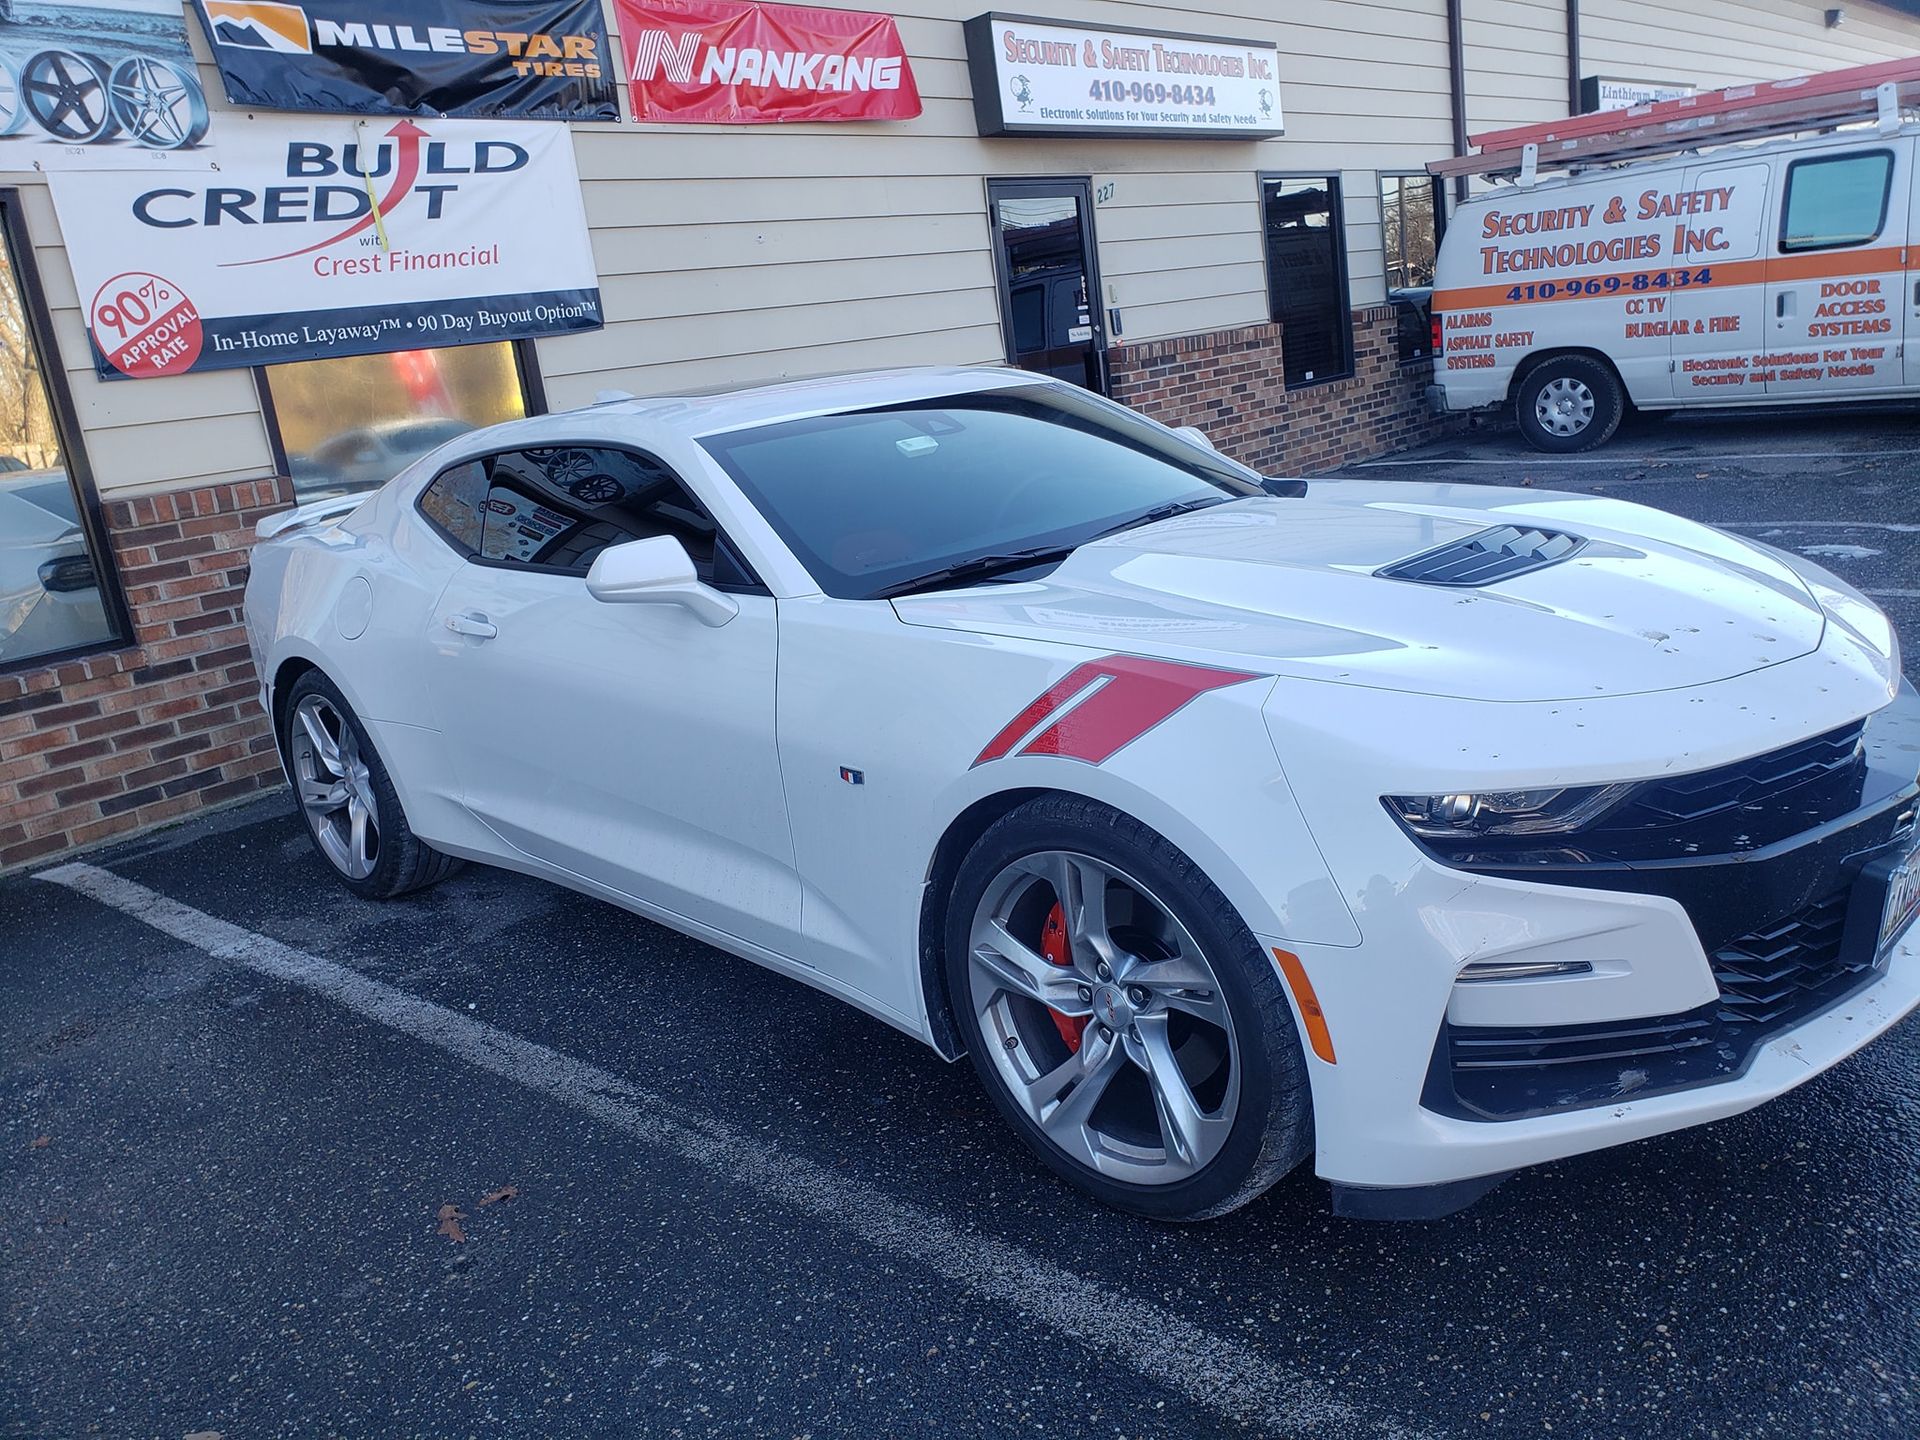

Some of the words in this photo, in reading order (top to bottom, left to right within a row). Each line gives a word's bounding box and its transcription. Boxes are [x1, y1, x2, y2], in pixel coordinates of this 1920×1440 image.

[1003, 30, 1077, 67] SECURITY
[1083, 39, 1098, 68] &
[1101, 39, 1150, 72] SAFETY
[1152, 43, 1244, 78] TECHNOLOGIES
[1247, 52, 1273, 80] INC.
[512, 61, 602, 79] TIRES
[699, 46, 902, 92] NANKANG
[1088, 79, 1216, 106] 410-969-8434
[1040, 107, 1084, 120] Electronic
[1086, 109, 1124, 121] Solutions
[1126, 110, 1139, 121] For
[1141, 111, 1158, 122] Your
[1160, 111, 1190, 124] Security
[1192, 112, 1207, 123] and
[1208, 113, 1232, 125] Safety
[1233, 113, 1257, 124] Needs
[1097, 183, 1115, 204] 227
[1482, 204, 1595, 239] SECURITY
[1603, 195, 1627, 224] &
[1637, 185, 1736, 221] SAFETY
[313, 254, 382, 277] Crest
[389, 244, 499, 272] Financial
[1480, 233, 1661, 275] TECHNOLOGIES
[1672, 224, 1730, 256] INC.
[1506, 267, 1712, 301] 410-969-8434
[1821, 279, 1881, 298] DOOR
[98, 278, 169, 339] 90%
[1625, 299, 1644, 314] CC
[1647, 296, 1667, 313] TV
[1814, 298, 1886, 318] ACCESS
[212, 330, 300, 352] In-Home
[417, 315, 438, 333] 90
[441, 313, 474, 331] Day
[477, 308, 533, 329] Buyout
[1445, 312, 1493, 330] ALARMS
[1625, 319, 1690, 338] BURGLAR
[1693, 318, 1705, 334] &
[1708, 315, 1740, 333] FIRE
[1808, 317, 1892, 337] SYSTEMS
[121, 307, 197, 369] APPROVAL
[1446, 334, 1493, 351] ASPHALT
[1494, 331, 1535, 348] SAFETY
[150, 336, 189, 369] RATE
[1447, 353, 1496, 370] SYSTEMS
[1682, 356, 1749, 373] Electronic
[1752, 351, 1819, 368] Solutions
[1823, 349, 1847, 363] For
[1850, 347, 1885, 361] Your
[1691, 372, 1746, 387] Security
[1748, 370, 1776, 383] and
[1779, 367, 1825, 381] Safety
[1828, 363, 1875, 378] Needs
